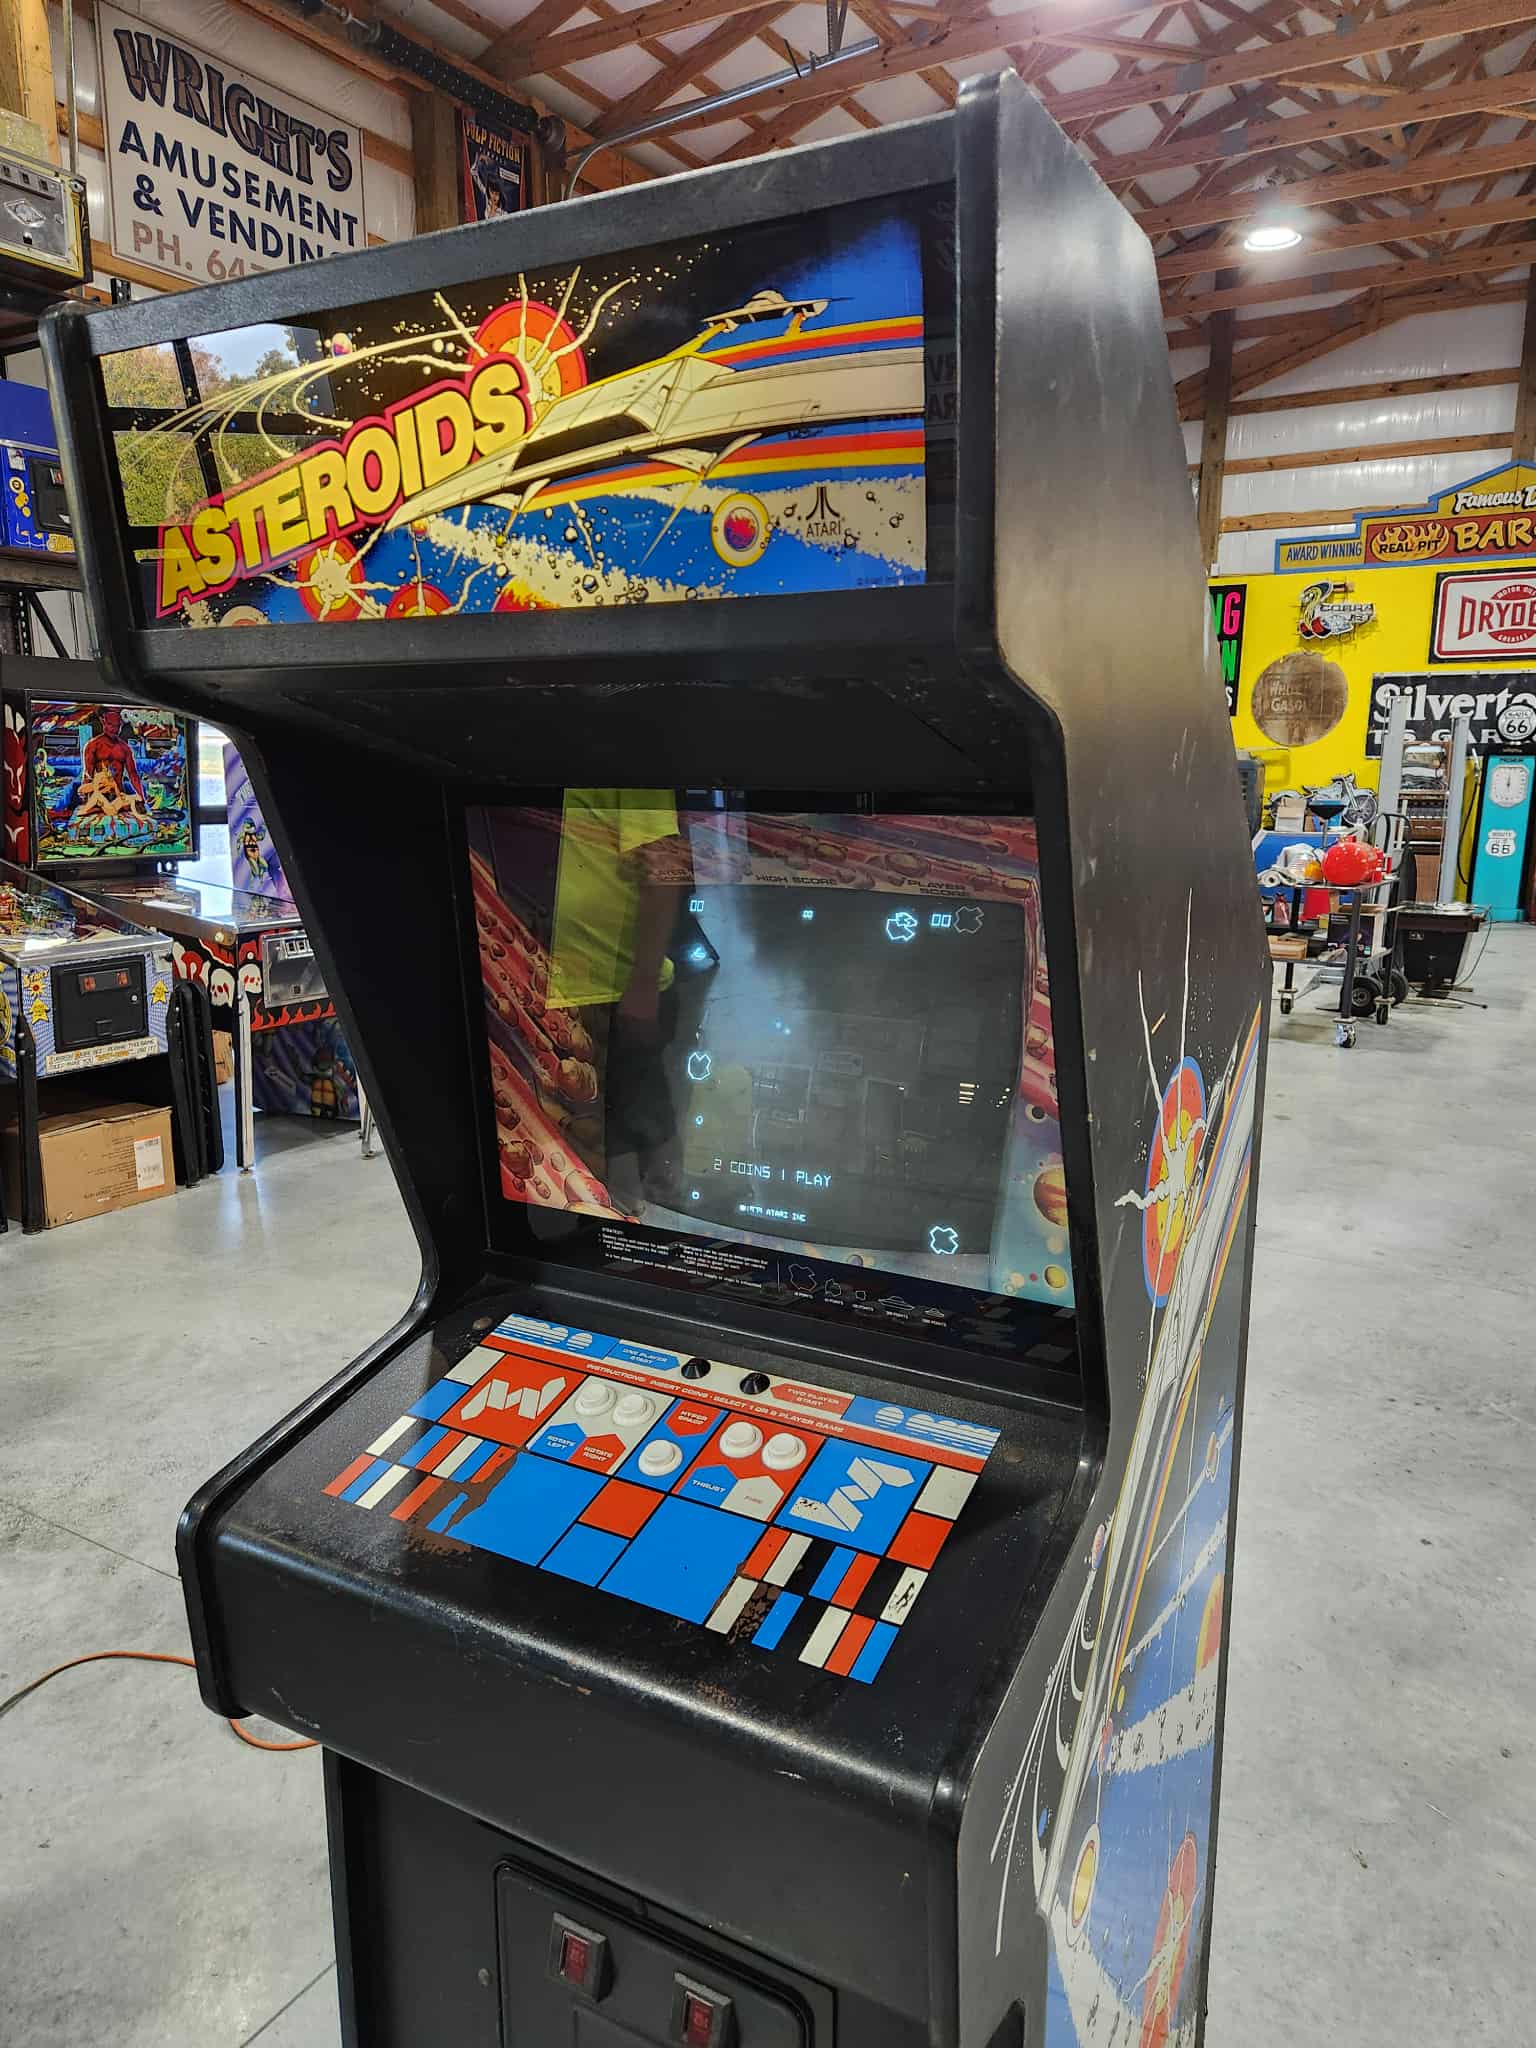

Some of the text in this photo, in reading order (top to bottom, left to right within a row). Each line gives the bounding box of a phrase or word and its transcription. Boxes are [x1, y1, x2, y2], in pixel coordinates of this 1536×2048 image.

[113, 28, 353, 192] WRIGHT'S
[488, 132, 521, 164] FICTION
[118, 119, 358, 247] AMUSEMENT
[132, 173, 347, 265] & VENDIN
[131, 219, 193, 272] PH.
[160, 361, 529, 609] ASTEROIDS
[1455, 490, 1522, 513] Famous
[806, 520, 842, 538] ATARI
[1452, 517, 1536, 551] BAR
[1286, 541, 1363, 562] AWARD WINNING
[1379, 540, 1442, 554] REAL PIT
[1320, 603, 1374, 614] COBRA
[1506, 719, 1528, 734] 66
[755, 874, 838, 886] HIGH SCORE
[907, 880, 966, 890] PLAYER
[919, 888, 970, 896] SCORE
[930, 913, 952, 928] 00
[714, 1158, 722, 1171] 2
[730, 1161, 771, 1179] COINS
[796, 1170, 832, 1188] PLAY
[766, 1207, 789, 1219] ATARI
[629, 1355, 654, 1365] START
[639, 1351, 668, 1362] PLAYER
[787, 1388, 840, 1405] TWO PLAYER
[796, 1397, 824, 1407] START
[650, 1379, 681, 1393] INSERT
[681, 1387, 709, 1399] COINS
[713, 1394, 747, 1409] SELECT
[753, 1406, 769, 1415] OR
[778, 1411, 815, 1426] PLAYER
[815, 1421, 845, 1433] GAME
[678, 1415, 705, 1425] SPACE
[680, 1410, 708, 1420] HYPER
[546, 1435, 577, 1447] ROTATE
[547, 1442, 568, 1450] LEFT
[584, 1446, 614, 1459] ROTATE
[584, 1452, 607, 1462] RIGHT
[692, 1479, 726, 1493] THRUST
